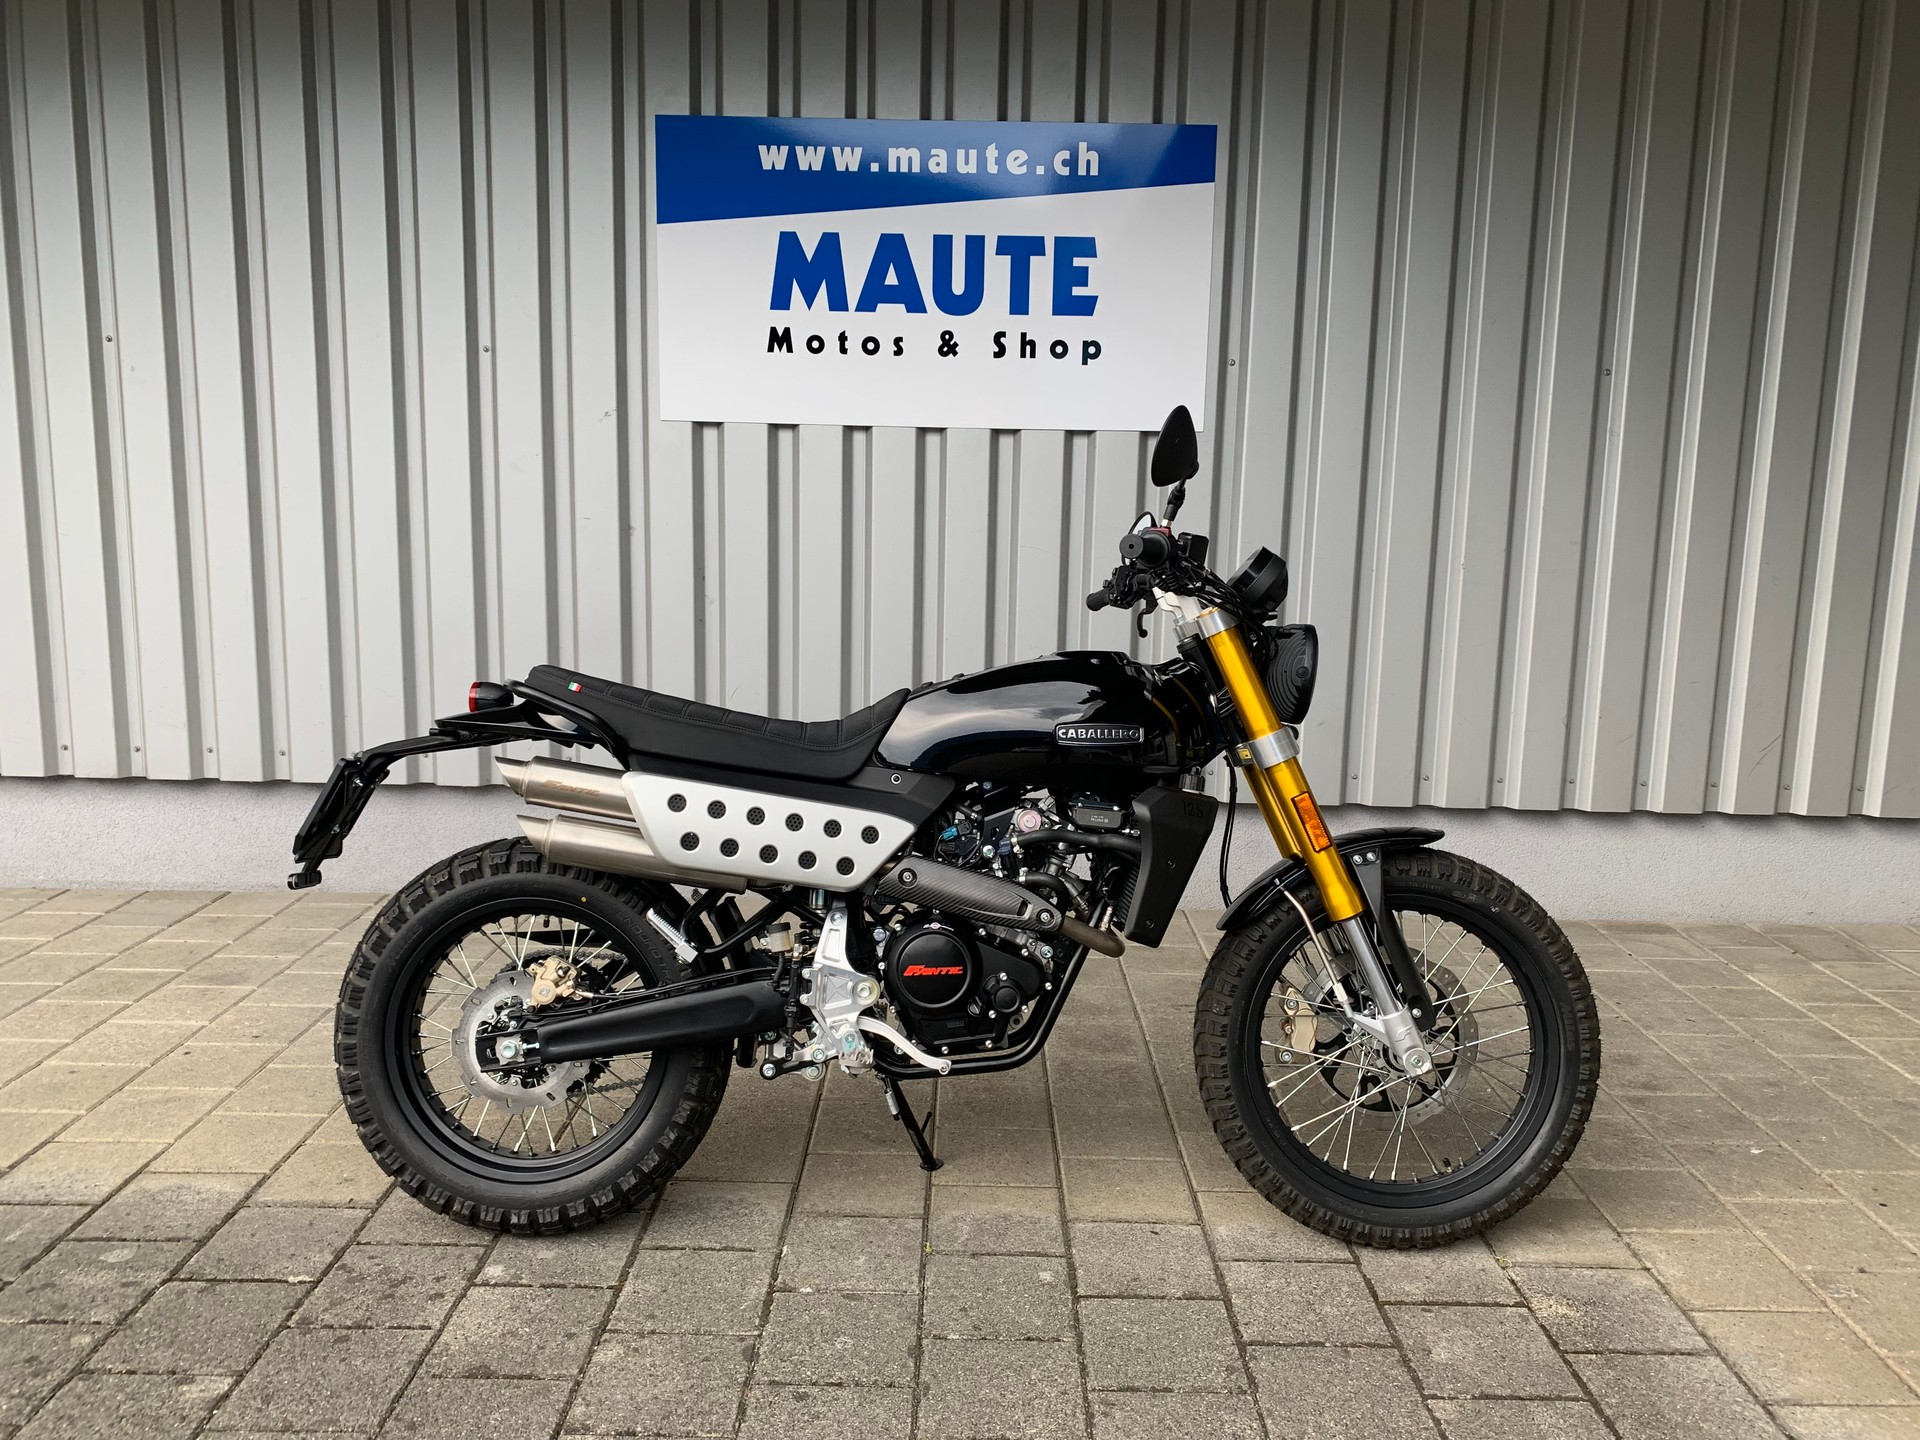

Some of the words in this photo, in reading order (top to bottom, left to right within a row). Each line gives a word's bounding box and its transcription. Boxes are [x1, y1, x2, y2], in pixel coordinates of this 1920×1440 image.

[758, 141, 1099, 176] www.maute.ch
[769, 230, 1099, 317] MAUTE
[766, 326, 904, 357] Motos
[937, 329, 960, 358] &
[992, 330, 1102, 366] Shop
[1058, 728, 1140, 739] CABALLERO
[1181, 799, 1205, 818] 125
[613, 909, 662, 961] ENDURO
[903, 964, 963, 977] FANTIC
